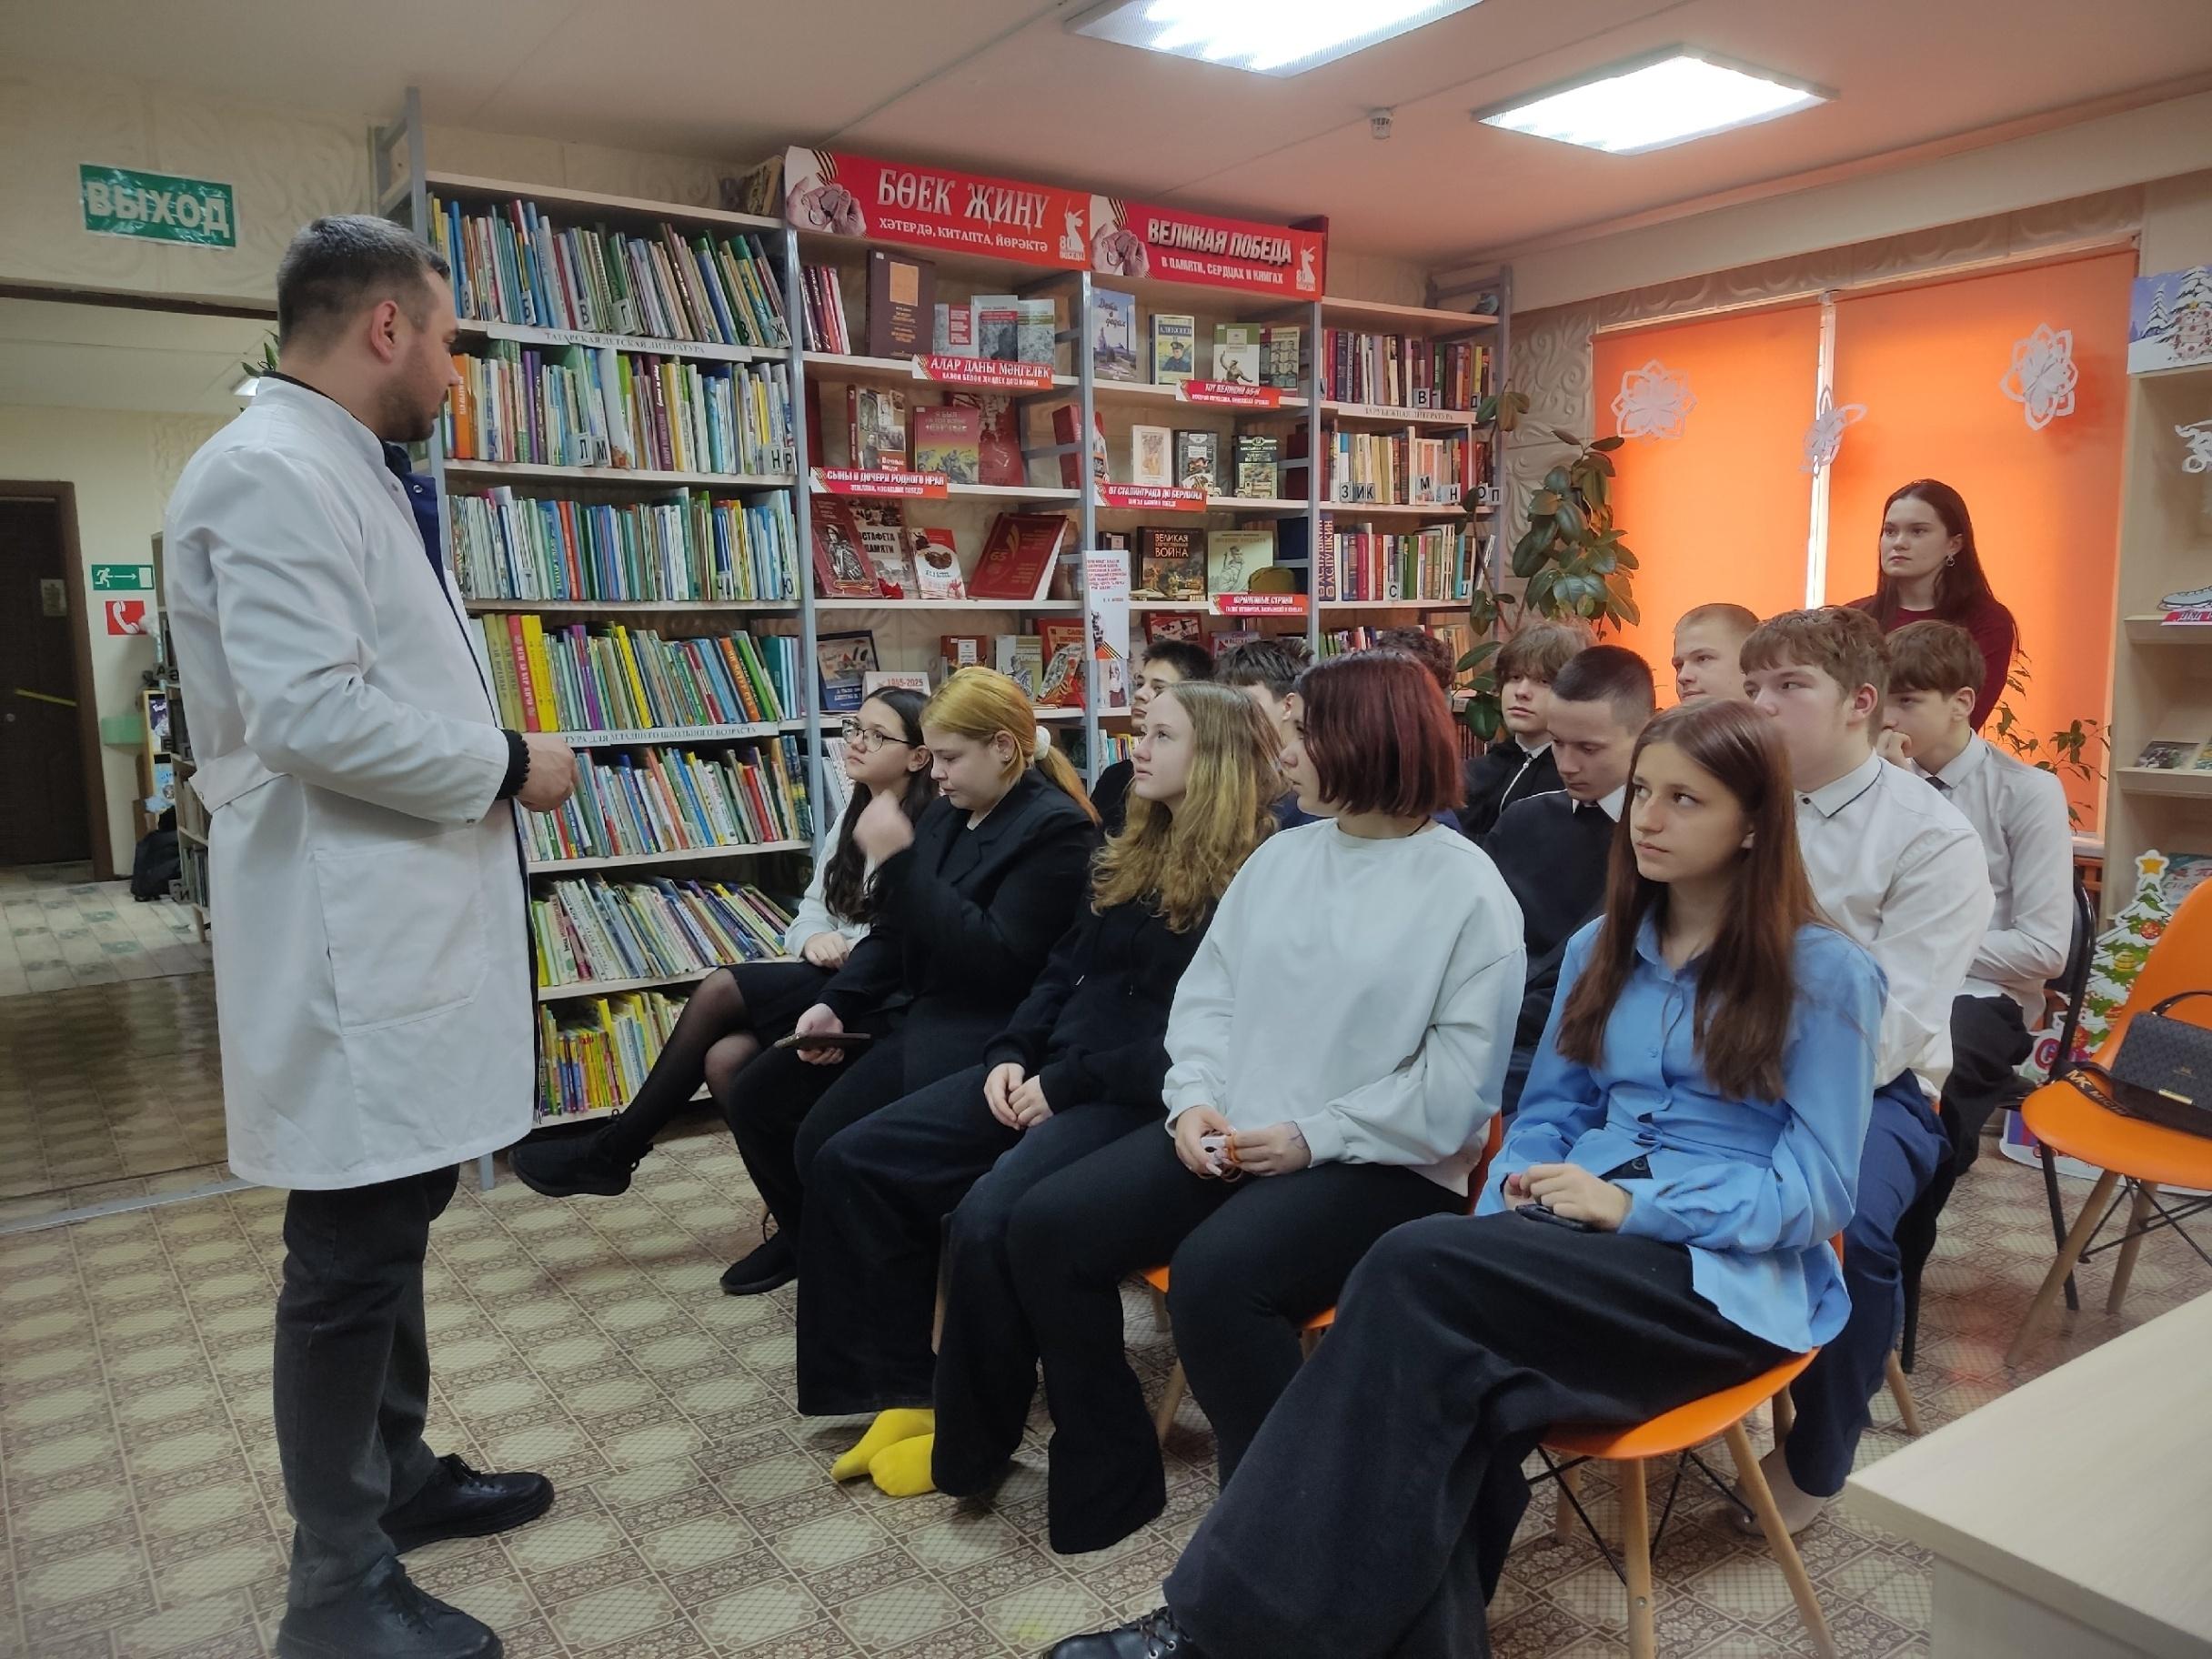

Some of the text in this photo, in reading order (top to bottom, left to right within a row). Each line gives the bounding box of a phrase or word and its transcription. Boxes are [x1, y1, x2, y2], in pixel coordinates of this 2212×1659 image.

[86, 181, 230, 238] ВЫХОД
[877, 169, 1050, 236] БӨЕК ҖИҢҮ
[880, 217, 1048, 253] ХӘТЕРДӘ, КИТАПТА, ЙӨРӘКТӘ
[1147, 218, 1292, 265] ВЕЛИКАЯ ПОБЕДА
[1161, 257, 1283, 285] В ПАМЯТИ, СЕРДЦАХ И КНИГАХ
[579, 304, 589, 325] В
[772, 323, 788, 342] Ж
[546, 332, 601, 343] ТАТАРСКАЯ
[648, 342, 705, 354] ЛИТЕРАТУРА
[930, 358, 960, 370] АЛАР
[964, 360, 996, 375] ДАНЫ
[1418, 391, 1427, 405] В
[596, 440, 608, 461] М
[771, 449, 780, 473] Н
[785, 453, 792, 471] Р
[827, 470, 852, 481] СЫНЫ
[860, 471, 890, 483] ДОЧЕРИ
[891, 473, 923, 485] РОДНОГО
[1420, 476, 1430, 491] М
[1109, 486, 1203, 500] ОТ СТАЛИНГРАДА ДО БЕРЛИНА
[1341, 485, 1349, 498] З
[1356, 485, 1364, 498] И
[1366, 485, 1373, 498] К
[1450, 488, 1458, 500] Н
[1492, 489, 1500, 500] П
[1155, 533, 1189, 542] ВЕЛИКАЯ
[1155, 547, 1189, 558] ВОЙНА
[1389, 585, 1397, 598] С
[716, 727, 757, 737] ВОЗРАСТА
